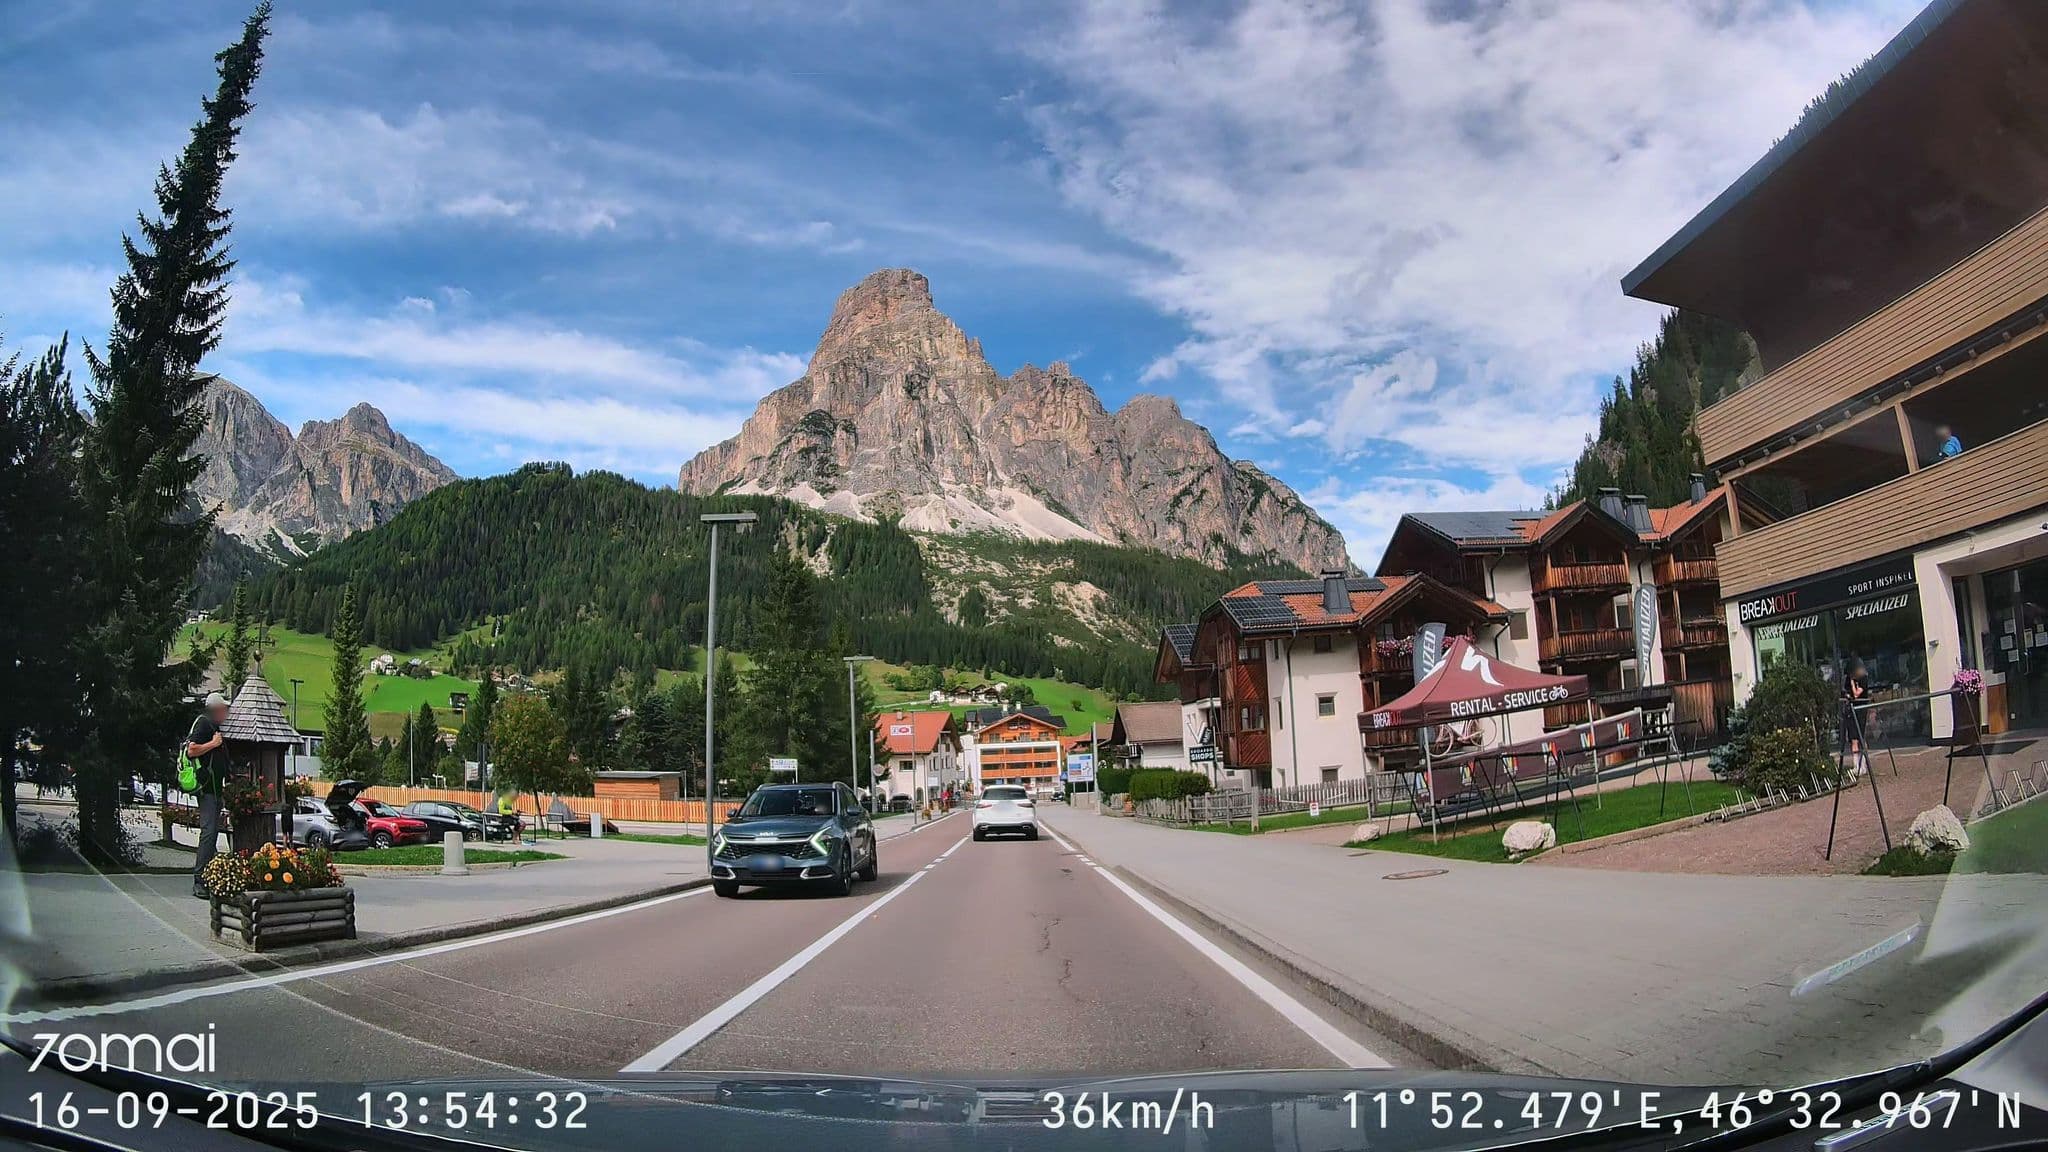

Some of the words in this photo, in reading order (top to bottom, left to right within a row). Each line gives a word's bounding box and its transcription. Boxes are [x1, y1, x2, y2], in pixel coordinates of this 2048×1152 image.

[1848, 580, 1873, 595] SPORT
[1740, 591, 1798, 621] BREAKOUT
[1845, 594, 1909, 620] SPECIALIZED
[1640, 588, 1651, 672] PECIALIZED
[1450, 697, 1496, 717] RENTAL
[1504, 688, 1549, 709] SERVICE
